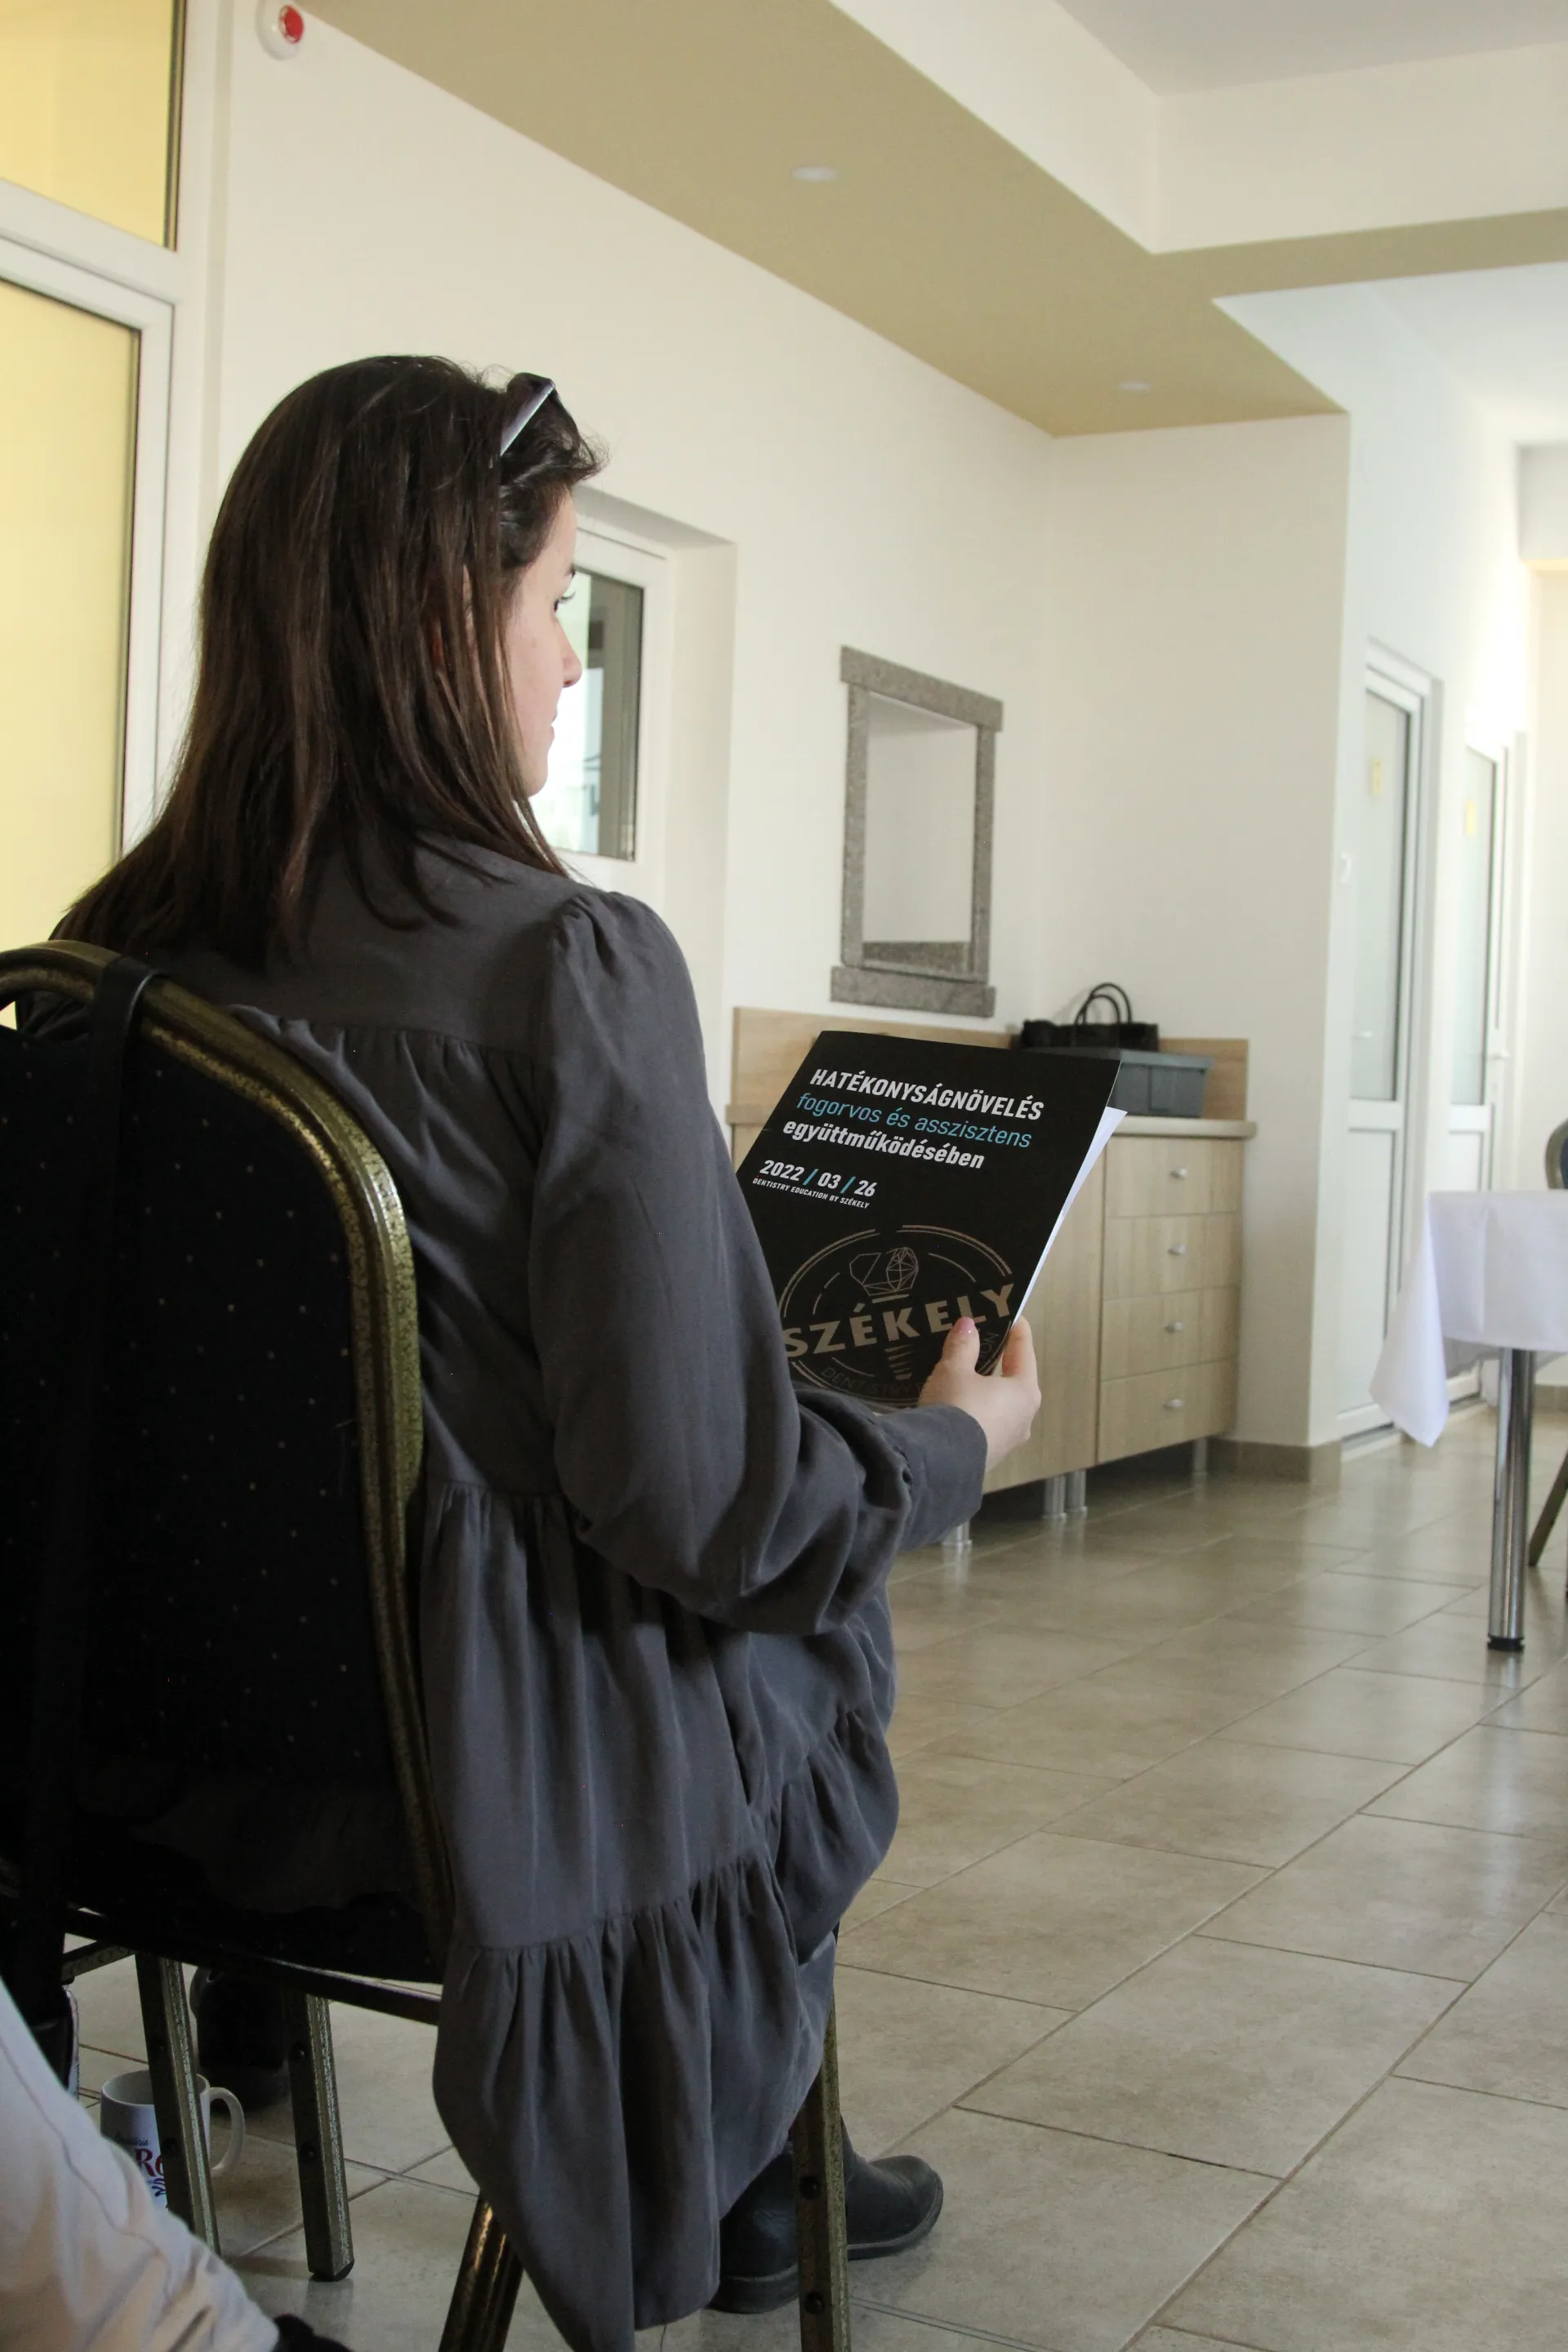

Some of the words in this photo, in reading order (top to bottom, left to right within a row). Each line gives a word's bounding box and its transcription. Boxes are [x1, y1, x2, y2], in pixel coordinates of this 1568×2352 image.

[809, 1068, 1045, 1121] HATÉKONYSÁGNÖVELÉS
[782, 1120, 986, 1169] együttműködésében
[796, 1093, 883, 1123] fogorvos
[886, 1107, 911, 1129] és
[914, 1116, 1032, 1148] asszisztens
[752, 1178, 791, 1192] DENTISTRY
[791, 1186, 828, 1200] EDUCATION
[829, 1195, 840, 1203] BY
[840, 1198, 870, 1209] SZÉKELY
[760, 1160, 805, 1182] 2022
[817, 1172, 842, 1189] 03
[854, 1179, 878, 1197] 26
[782, 1283, 1014, 1358] SZÉKELY
